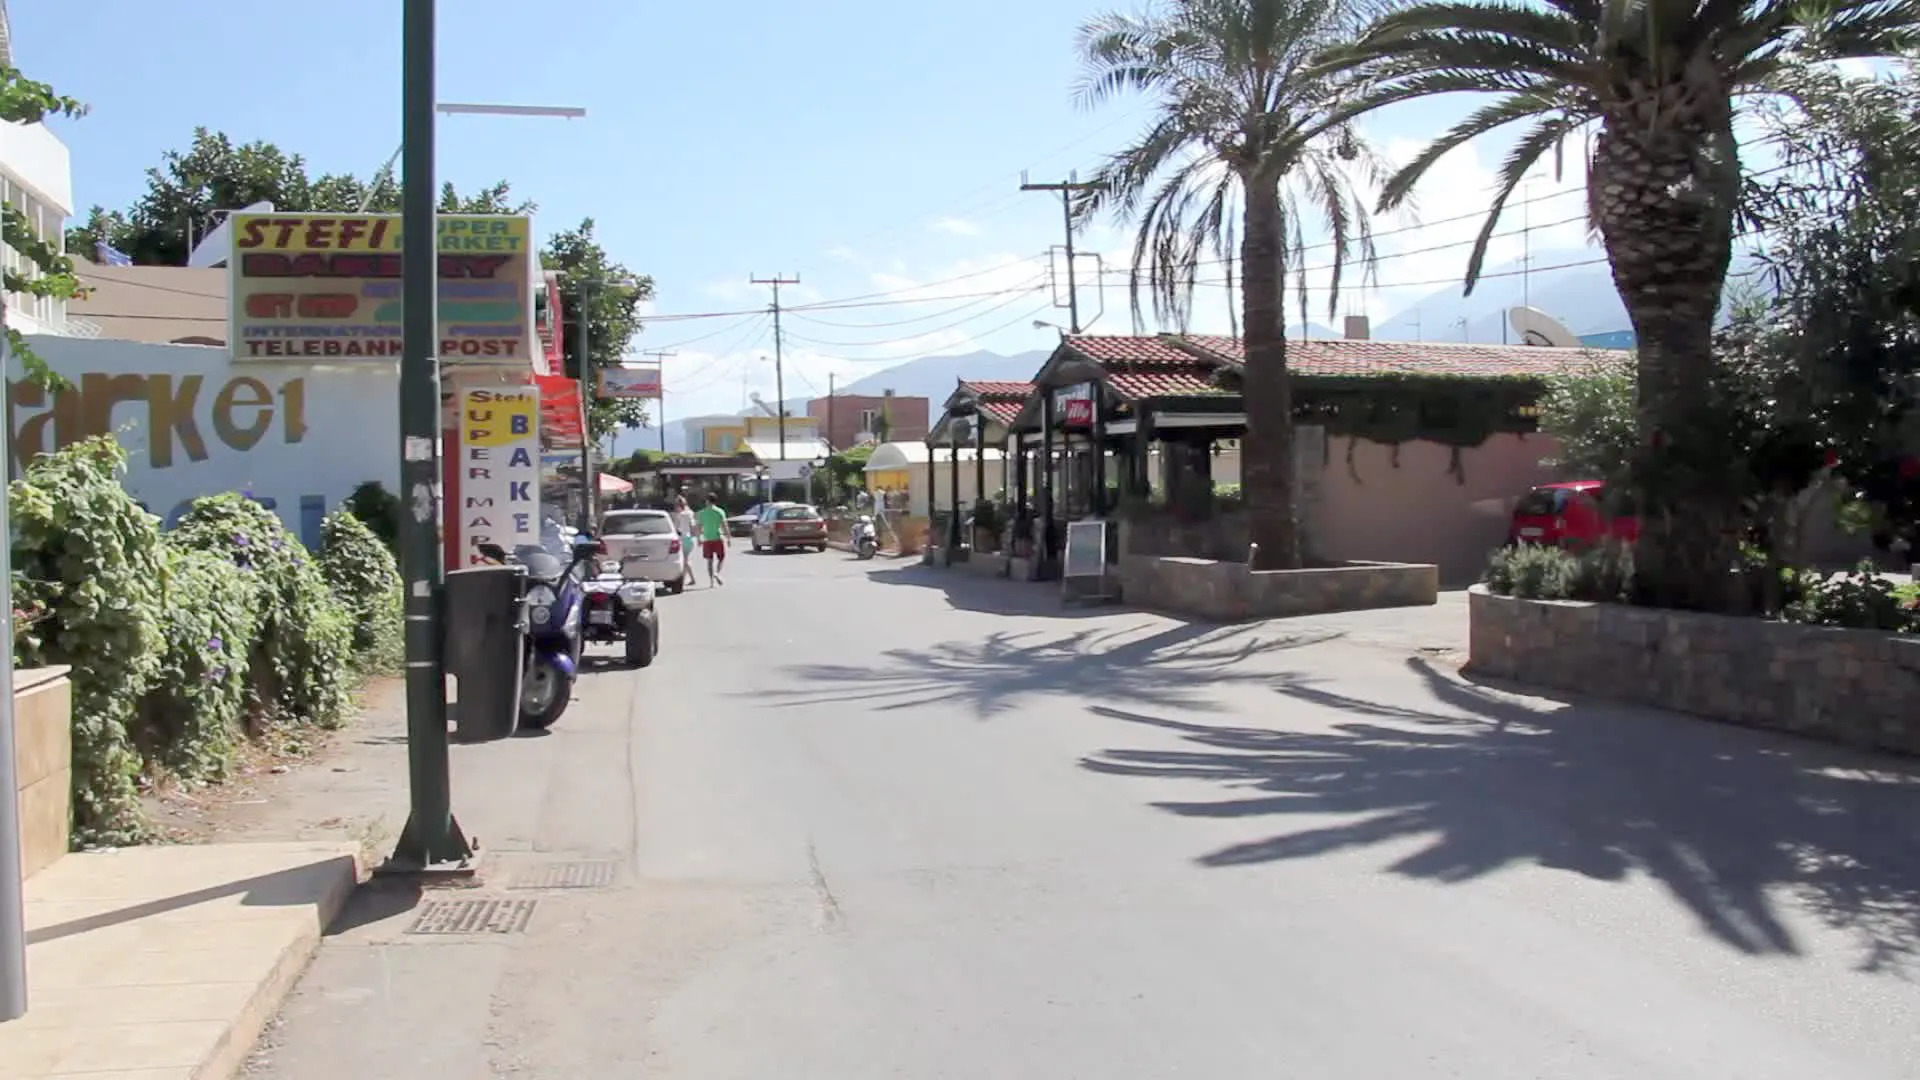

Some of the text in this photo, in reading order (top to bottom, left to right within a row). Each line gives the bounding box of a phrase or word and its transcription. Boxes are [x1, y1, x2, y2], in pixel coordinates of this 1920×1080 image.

[238, 219, 389, 249] STEFI
[441, 340, 518, 356] POST
[6, 373, 308, 470] arket
